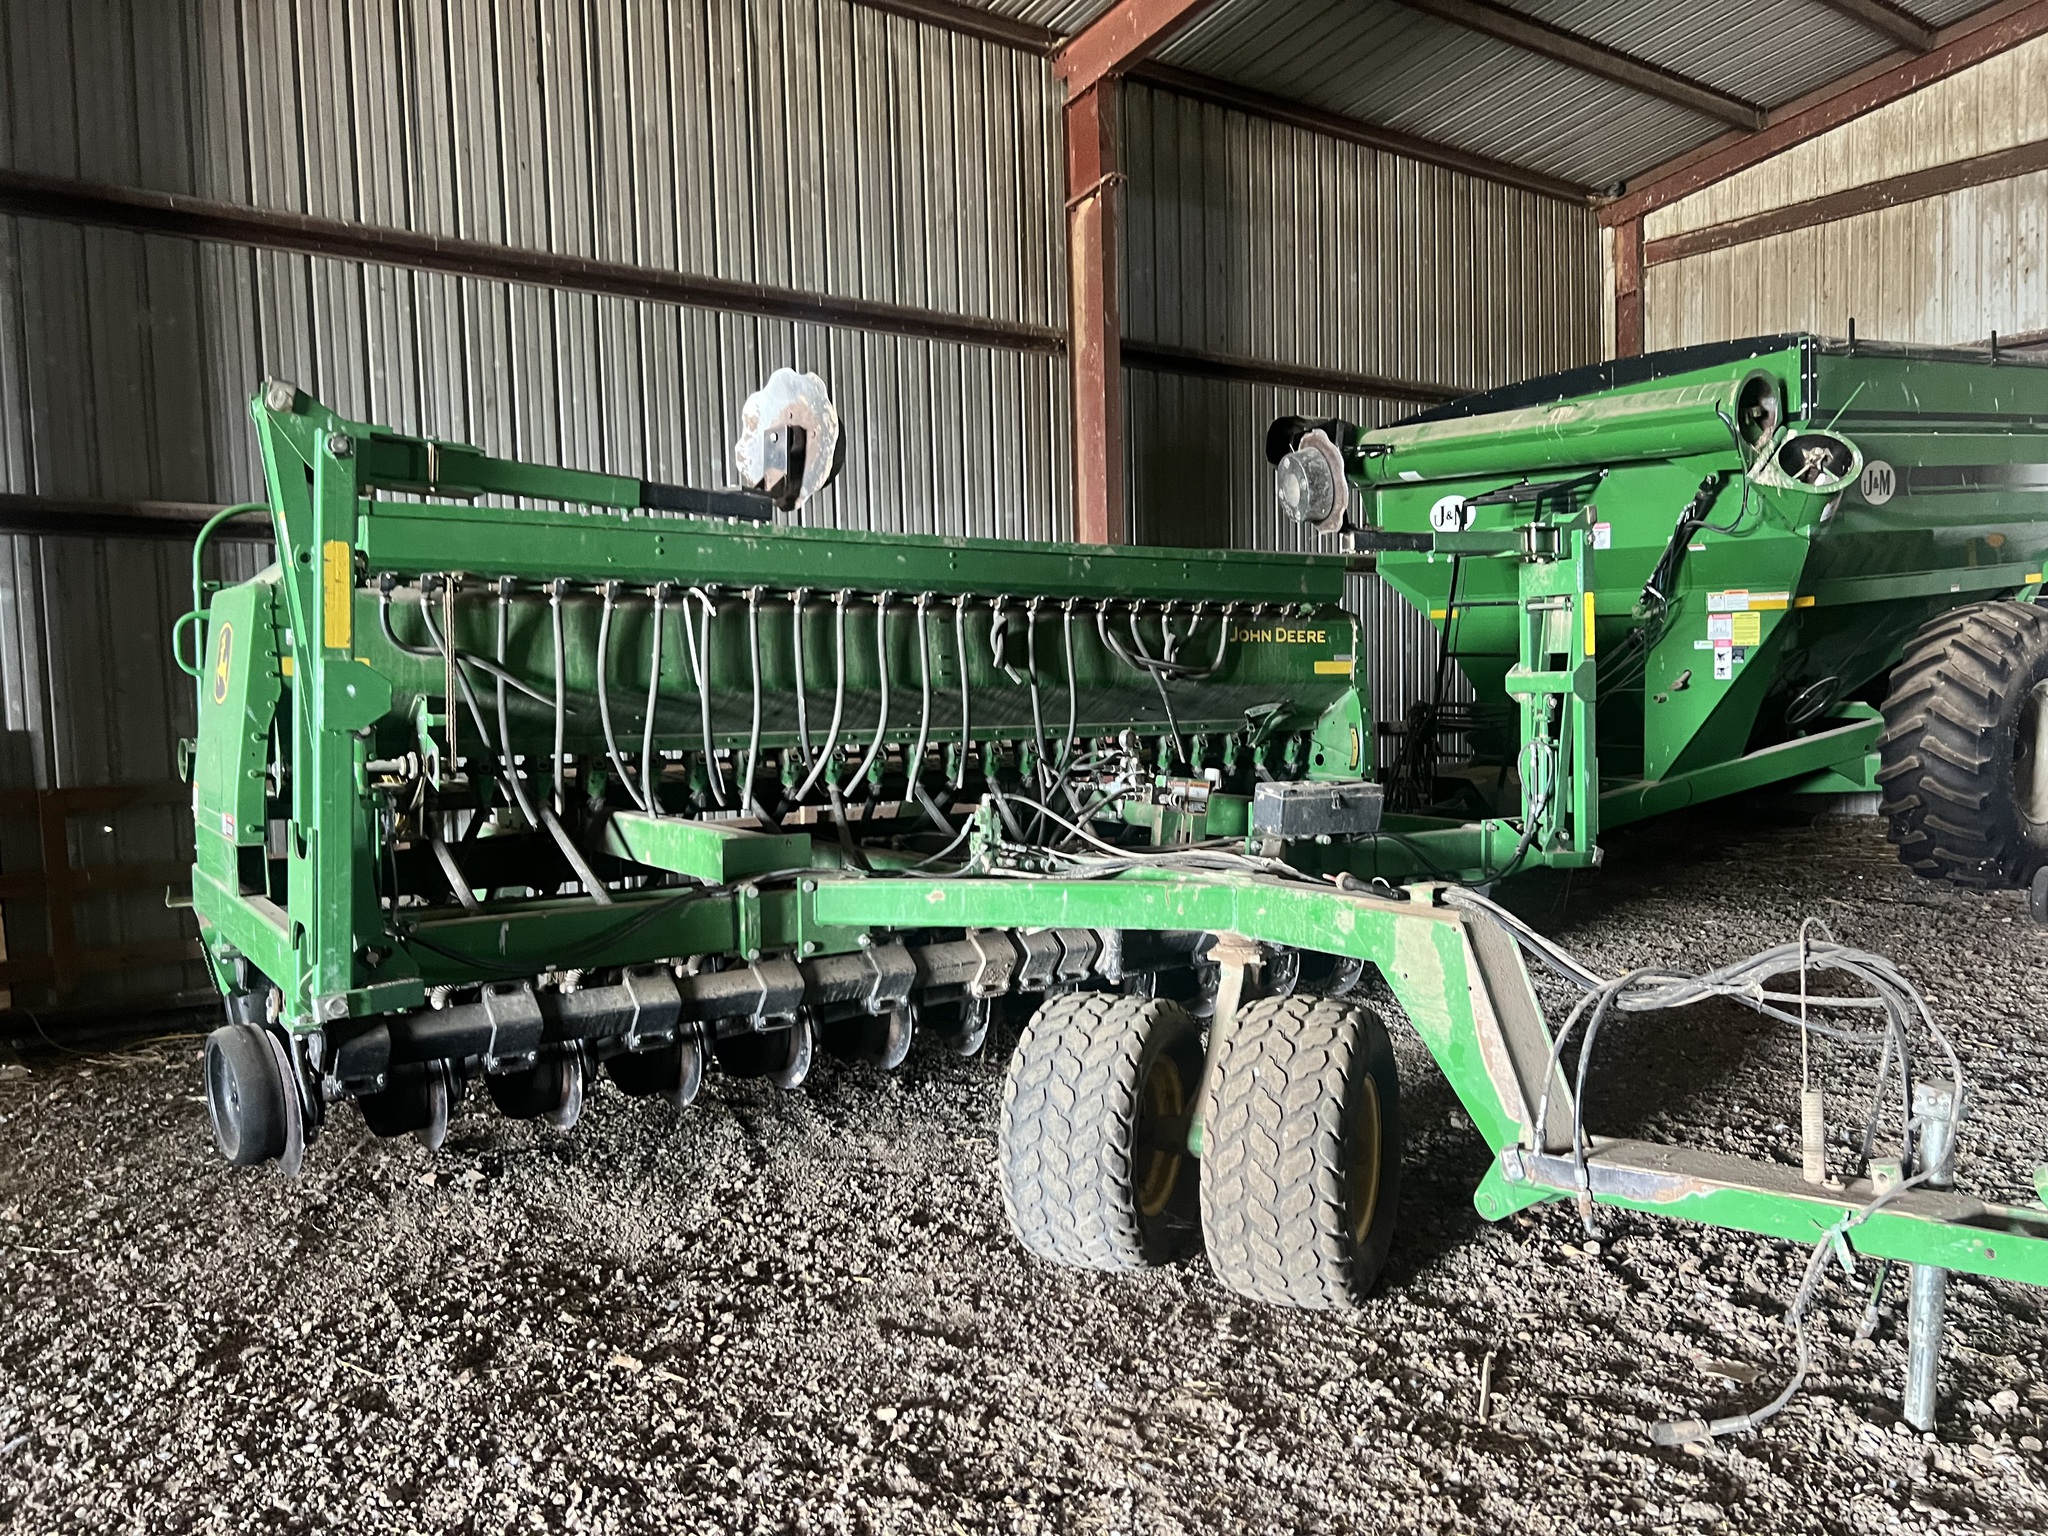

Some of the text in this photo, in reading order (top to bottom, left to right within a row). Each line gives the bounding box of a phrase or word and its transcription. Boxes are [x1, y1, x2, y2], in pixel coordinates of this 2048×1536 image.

[1863, 469, 1891, 496] J&M
[1230, 626, 1326, 643] JOHN DEERE
